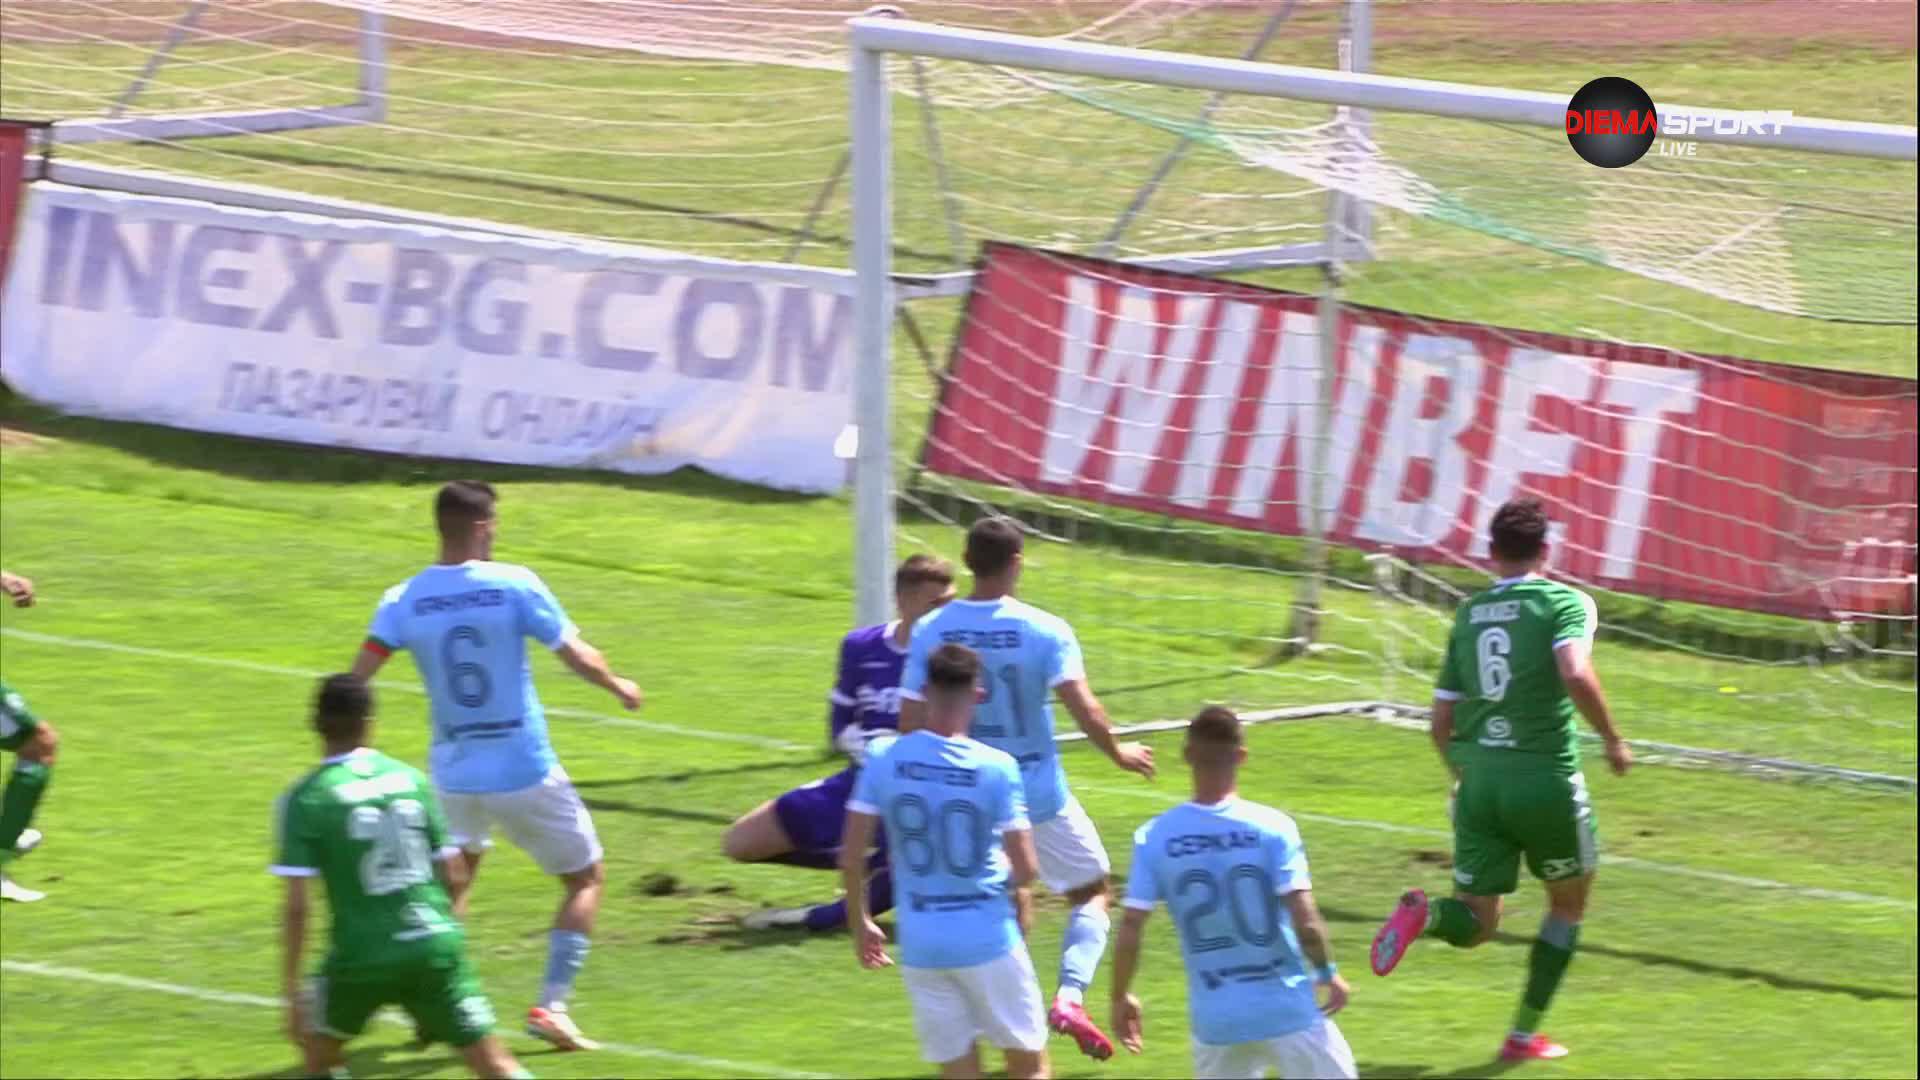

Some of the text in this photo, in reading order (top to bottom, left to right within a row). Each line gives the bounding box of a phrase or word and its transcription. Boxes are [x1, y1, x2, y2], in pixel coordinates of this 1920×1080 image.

[39, 205, 852, 393] INEX-BG.COM
[1038, 274, 1701, 582] WINBET
[440, 625, 493, 709] 6
[1476, 626, 1512, 703] 6
[891, 793, 986, 878] 80
[1165, 830, 1261, 859] СЕРКАН
[1174, 863, 1280, 955] 20
